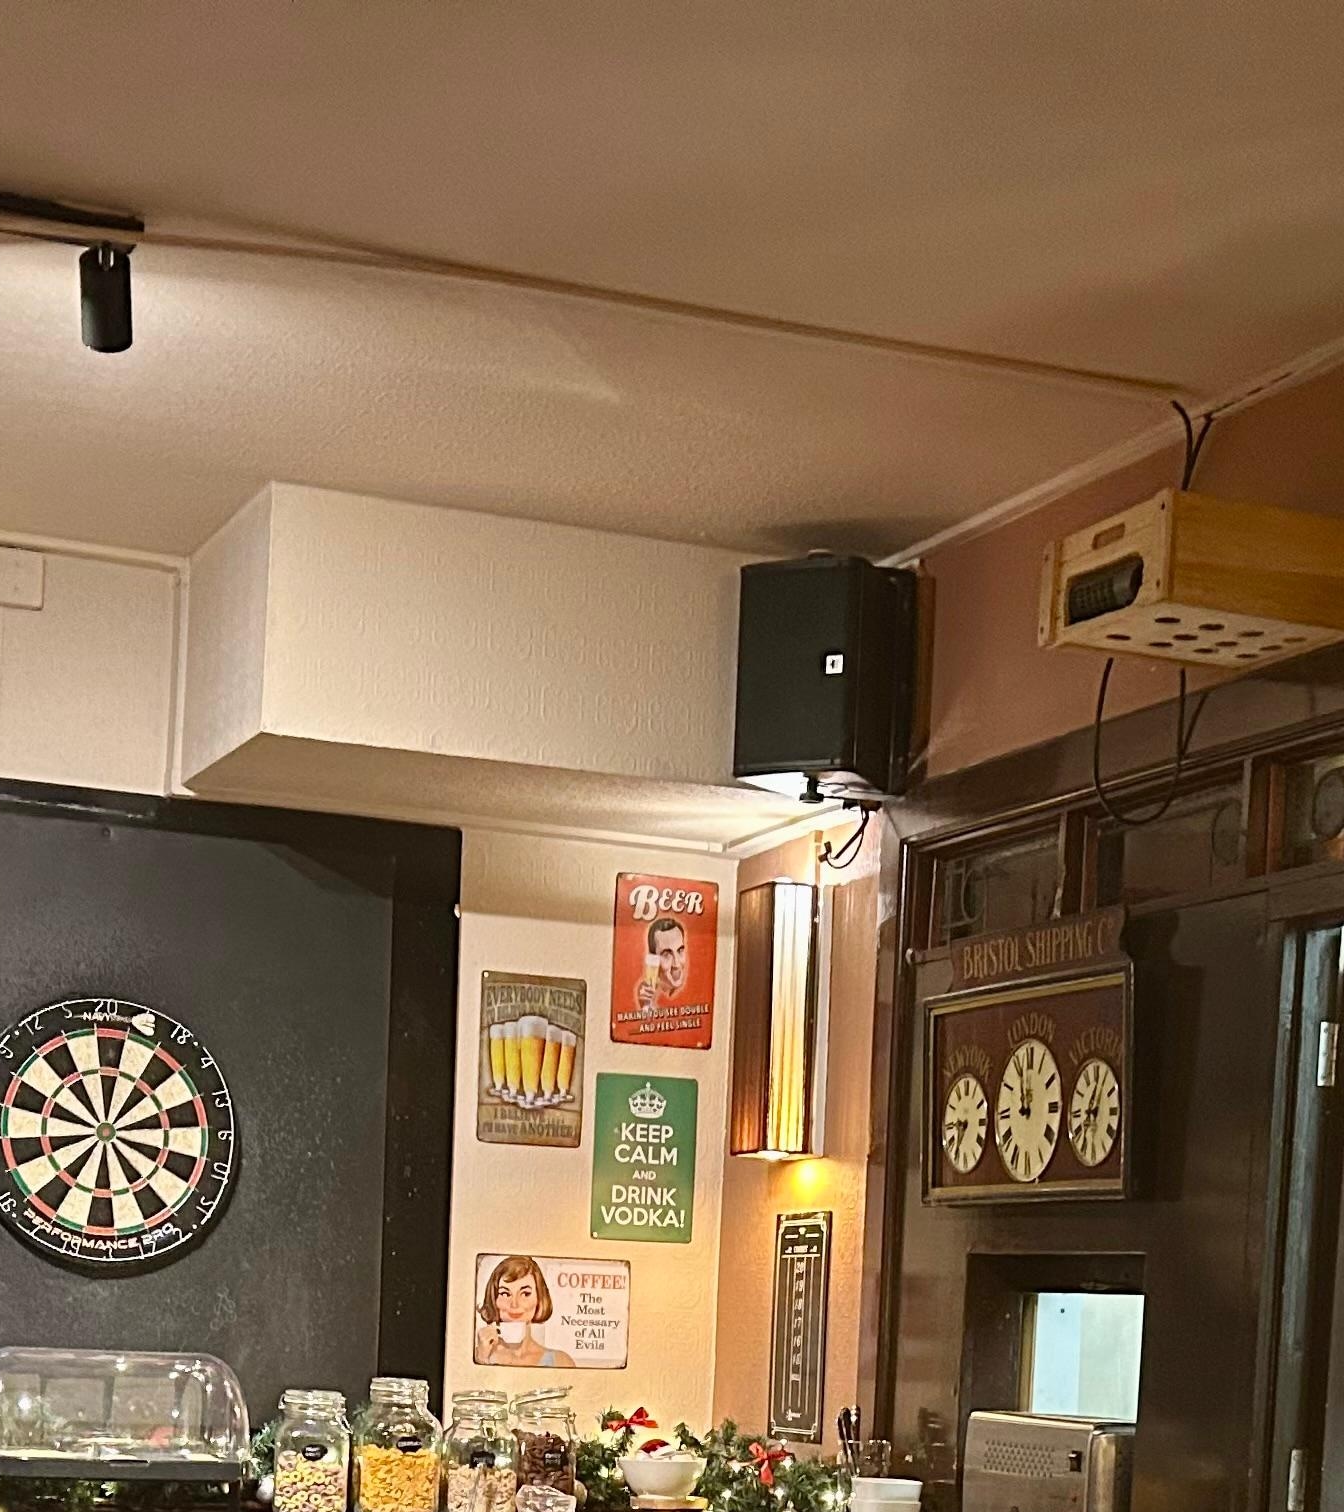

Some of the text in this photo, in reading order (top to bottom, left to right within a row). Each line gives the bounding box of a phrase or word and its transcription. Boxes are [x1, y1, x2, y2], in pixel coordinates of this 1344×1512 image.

[629, 885, 704, 921] BEER
[963, 936, 1024, 980] BRISTOL
[1026, 921, 1093, 968] SHIPPING
[486, 986, 547, 1007] EVERYBODY
[549, 989, 583, 1016] NEEDS
[639, 1022, 656, 1033] AND
[1007, 1012, 1056, 1046] LONDON
[621, 1122, 674, 1144] KEEP
[614, 1144, 678, 1166] CALM
[632, 1169, 657, 1181] AND
[611, 1184, 677, 1207] DRINK
[600, 1205, 686, 1229] VODKA!
[23, 1207, 138, 1251] PERFORMANCE
[141, 1222, 174, 1245] PRO
[557, 1272, 626, 1290] COFFEE!
[580, 1293, 603, 1304] The
[576, 1305, 606, 1316] Most
[561, 1316, 621, 1330] Necessary
[574, 1328, 605, 1339] of All
[575, 1339, 605, 1351] Evils
